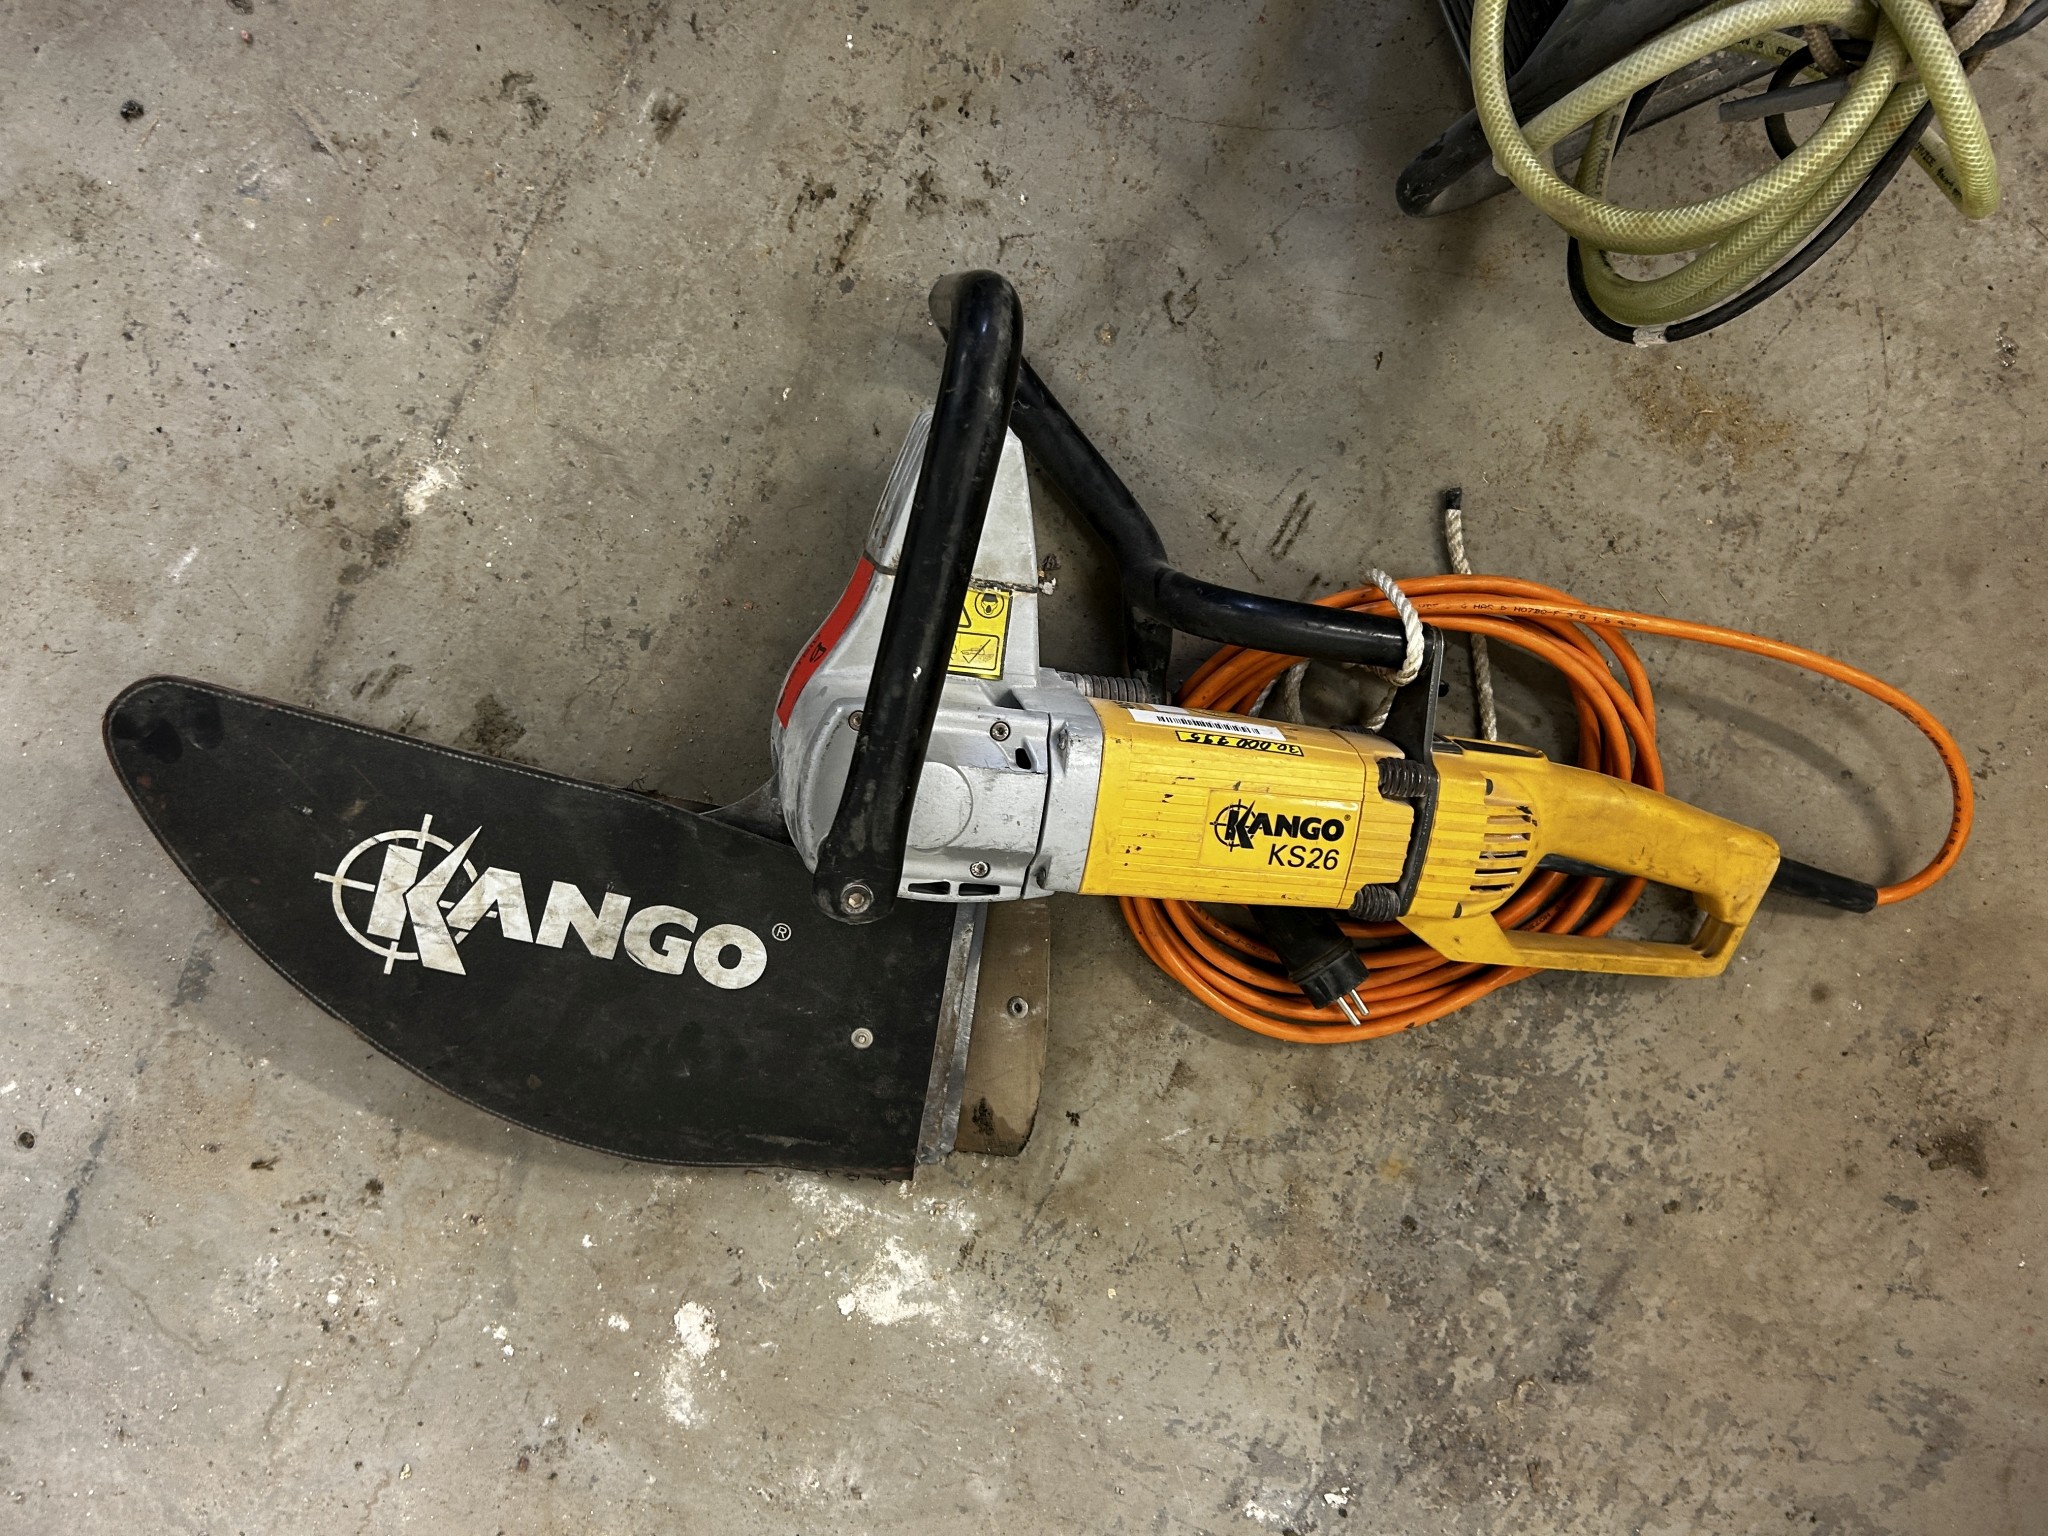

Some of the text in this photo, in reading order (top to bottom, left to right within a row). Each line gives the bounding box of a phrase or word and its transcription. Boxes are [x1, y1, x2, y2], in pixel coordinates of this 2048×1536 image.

[1224, 801, 1345, 850] KANGO
[1267, 843, 1341, 871] KS26
[366, 824, 768, 990] KANGO
